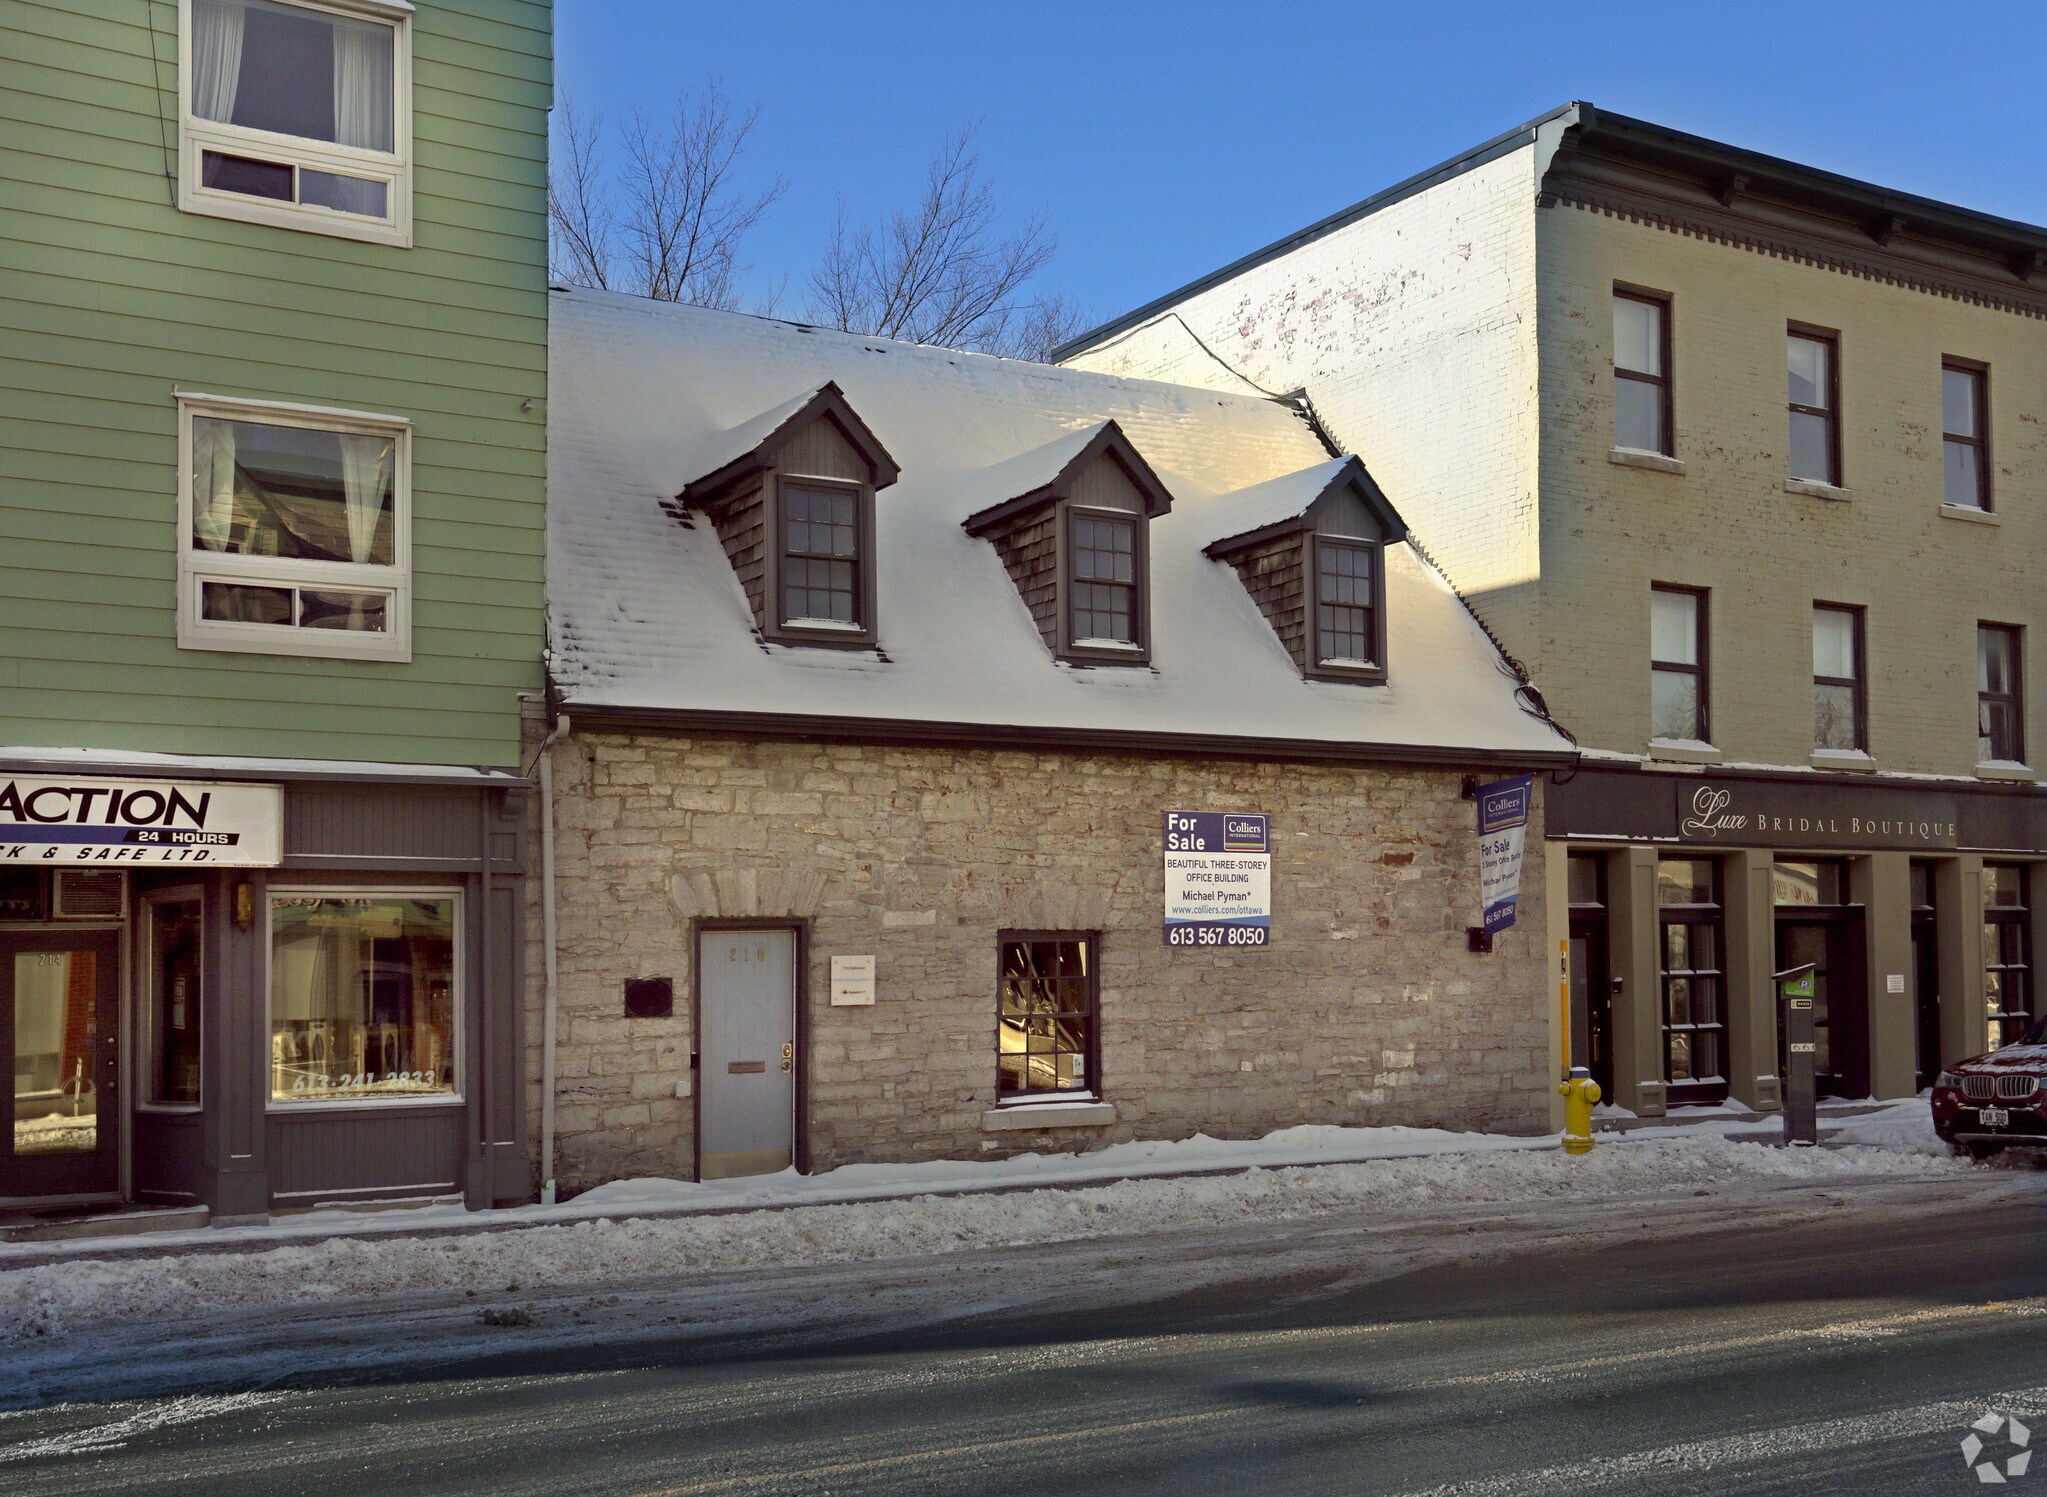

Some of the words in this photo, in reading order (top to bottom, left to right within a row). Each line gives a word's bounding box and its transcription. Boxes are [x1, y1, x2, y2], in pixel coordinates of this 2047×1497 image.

[0, 780, 211, 830] ACTION
[1488, 799, 1520, 813] Colliers
[1682, 786, 1748, 838] Luxe
[1758, 814, 1838, 833] BRIDAL
[1852, 817, 1956, 839] BOUTIQUE
[1168, 814, 1197, 831] For
[1228, 821, 1261, 833] Colliers
[138, 831, 160, 842] 24
[172, 832, 229, 844] HOURS
[1168, 833, 1206, 851] Sale
[42, 846, 59, 859] &
[77, 847, 147, 860] SAFE
[161, 849, 216, 861] LTD.
[1481, 844, 1492, 858] For
[1494, 839, 1510, 854] Sale
[1167, 859, 1208, 868] BEAUTIFUL
[1211, 860, 1267, 870] THREE-STOREY
[1186, 873, 1212, 882] OFFICE
[1214, 874, 1249, 883] BUILDING
[1182, 890, 1215, 901] Michael
[1172, 904, 1263, 915] www.colliers.com/ottawa
[1169, 927, 1195, 945] 613
[1198, 927, 1225, 945] 567
[1227, 927, 1265, 945] 8050
[39, 953, 62, 966] 214
